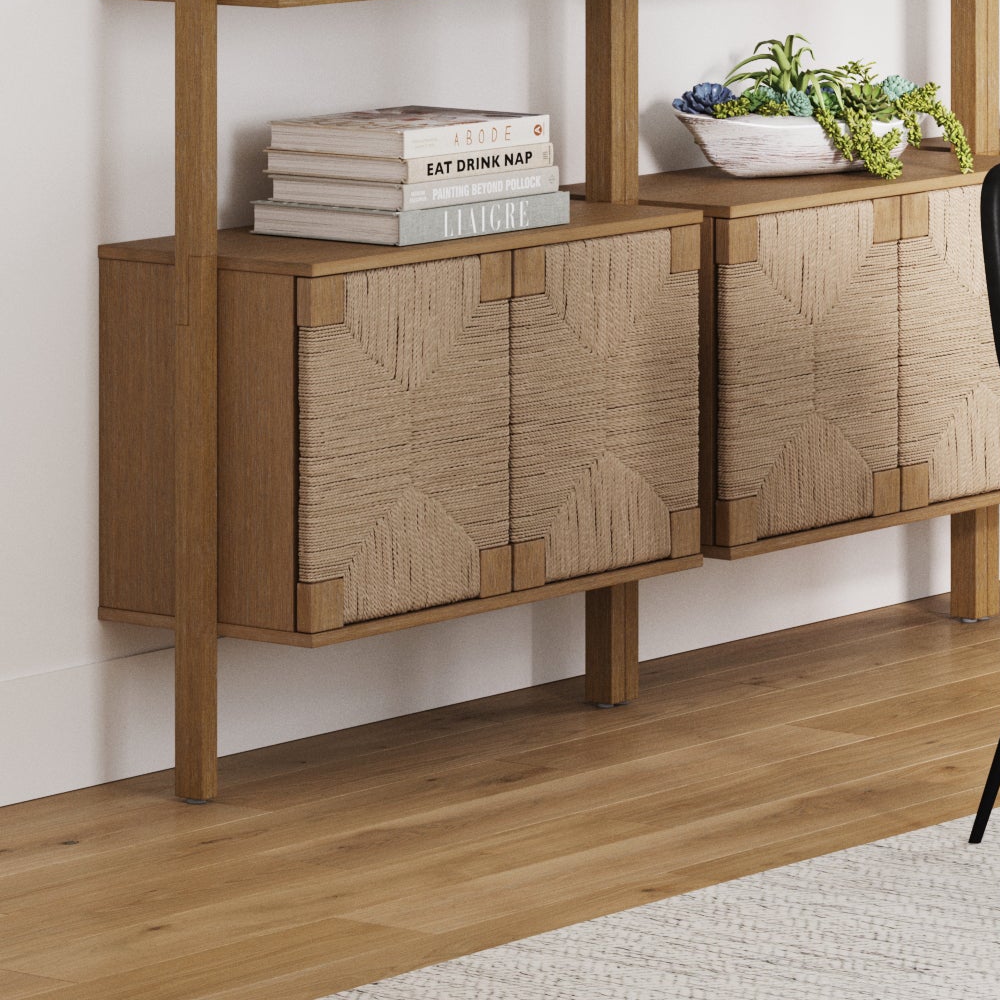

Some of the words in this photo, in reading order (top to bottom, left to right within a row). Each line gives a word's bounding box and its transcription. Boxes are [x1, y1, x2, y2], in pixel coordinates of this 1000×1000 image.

[427, 161, 452, 176] EAT
[456, 155, 500, 172] DRINK
[504, 151, 533, 167] NAP
[432, 183, 470, 200] PAINTING
[471, 180, 504, 196] BEYOND
[505, 175, 541, 192] POLLOCK
[444, 200, 530, 237] LIAIGRE
